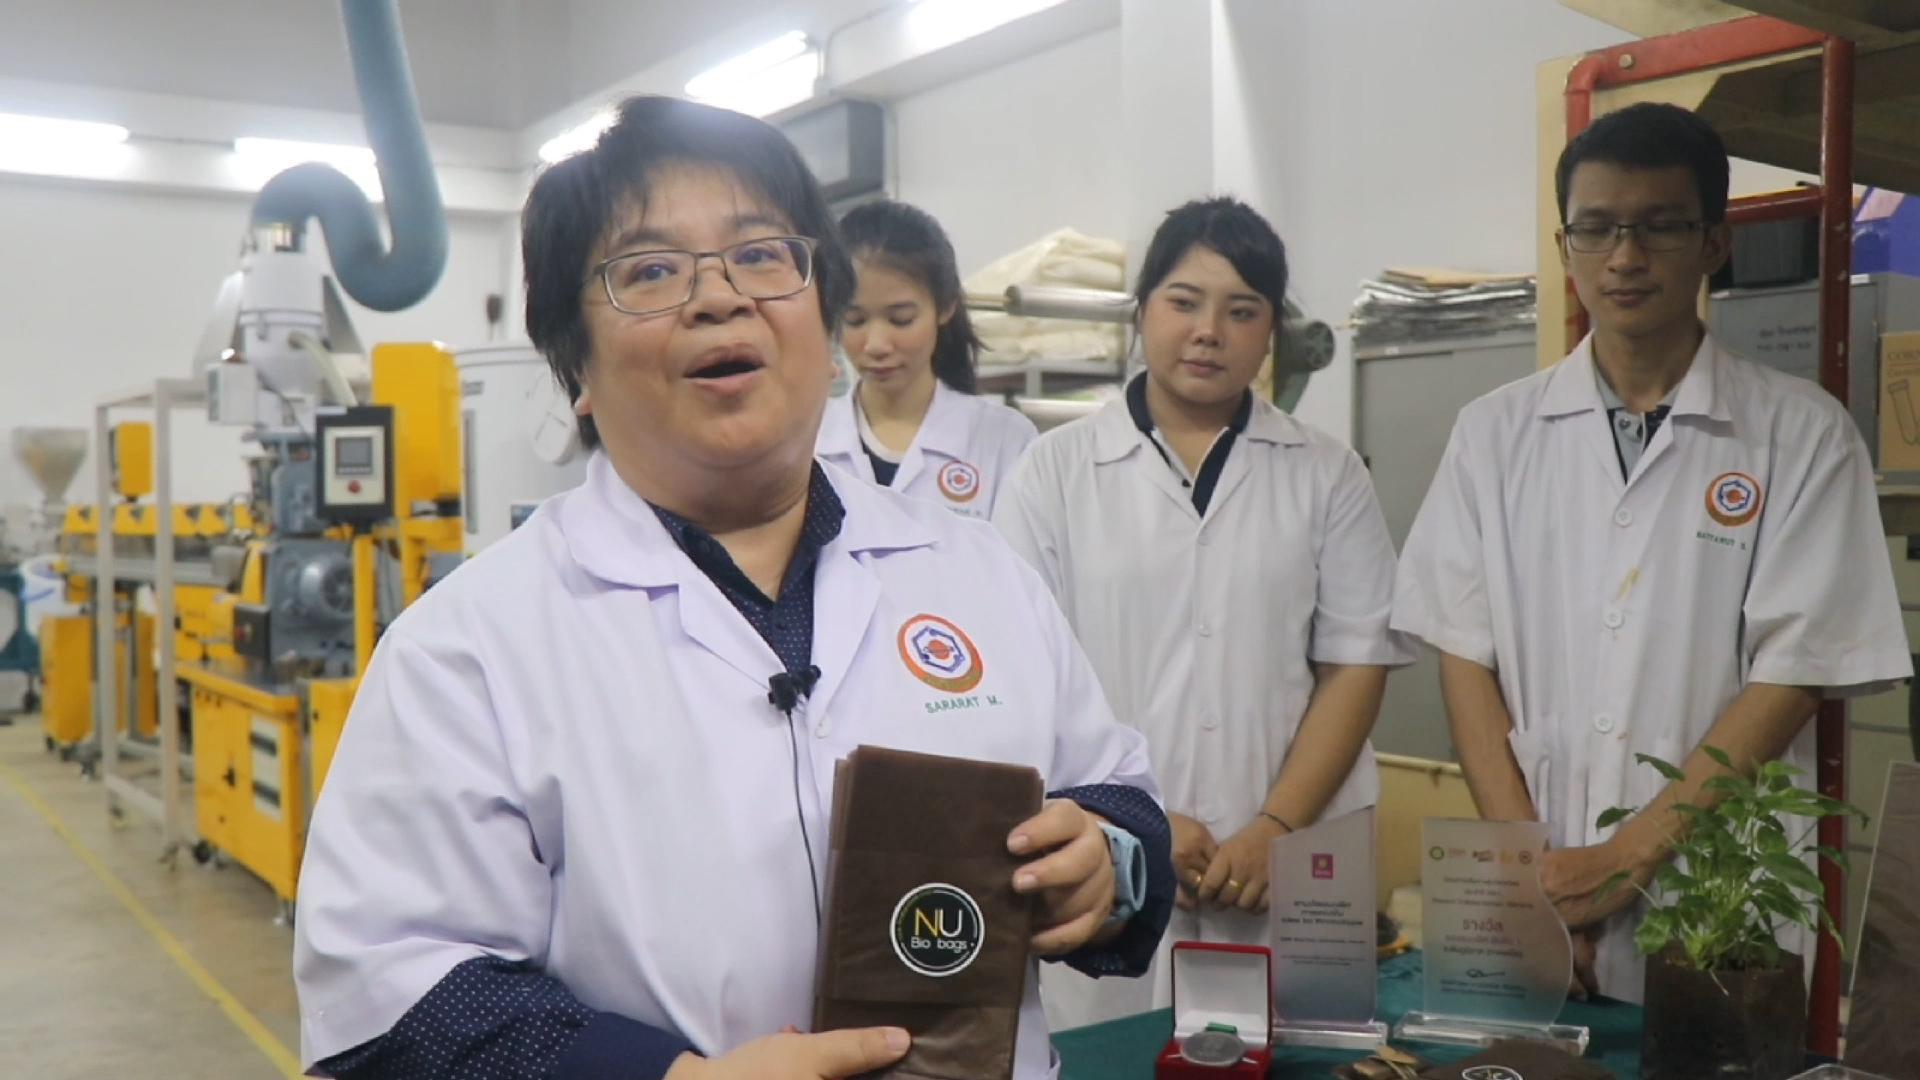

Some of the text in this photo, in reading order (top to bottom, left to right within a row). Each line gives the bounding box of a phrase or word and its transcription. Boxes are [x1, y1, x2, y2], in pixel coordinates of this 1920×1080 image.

[925, 695, 1004, 714] SARARAT M.
[914, 907, 963, 937] NU
[910, 936, 932, 949] Bio
